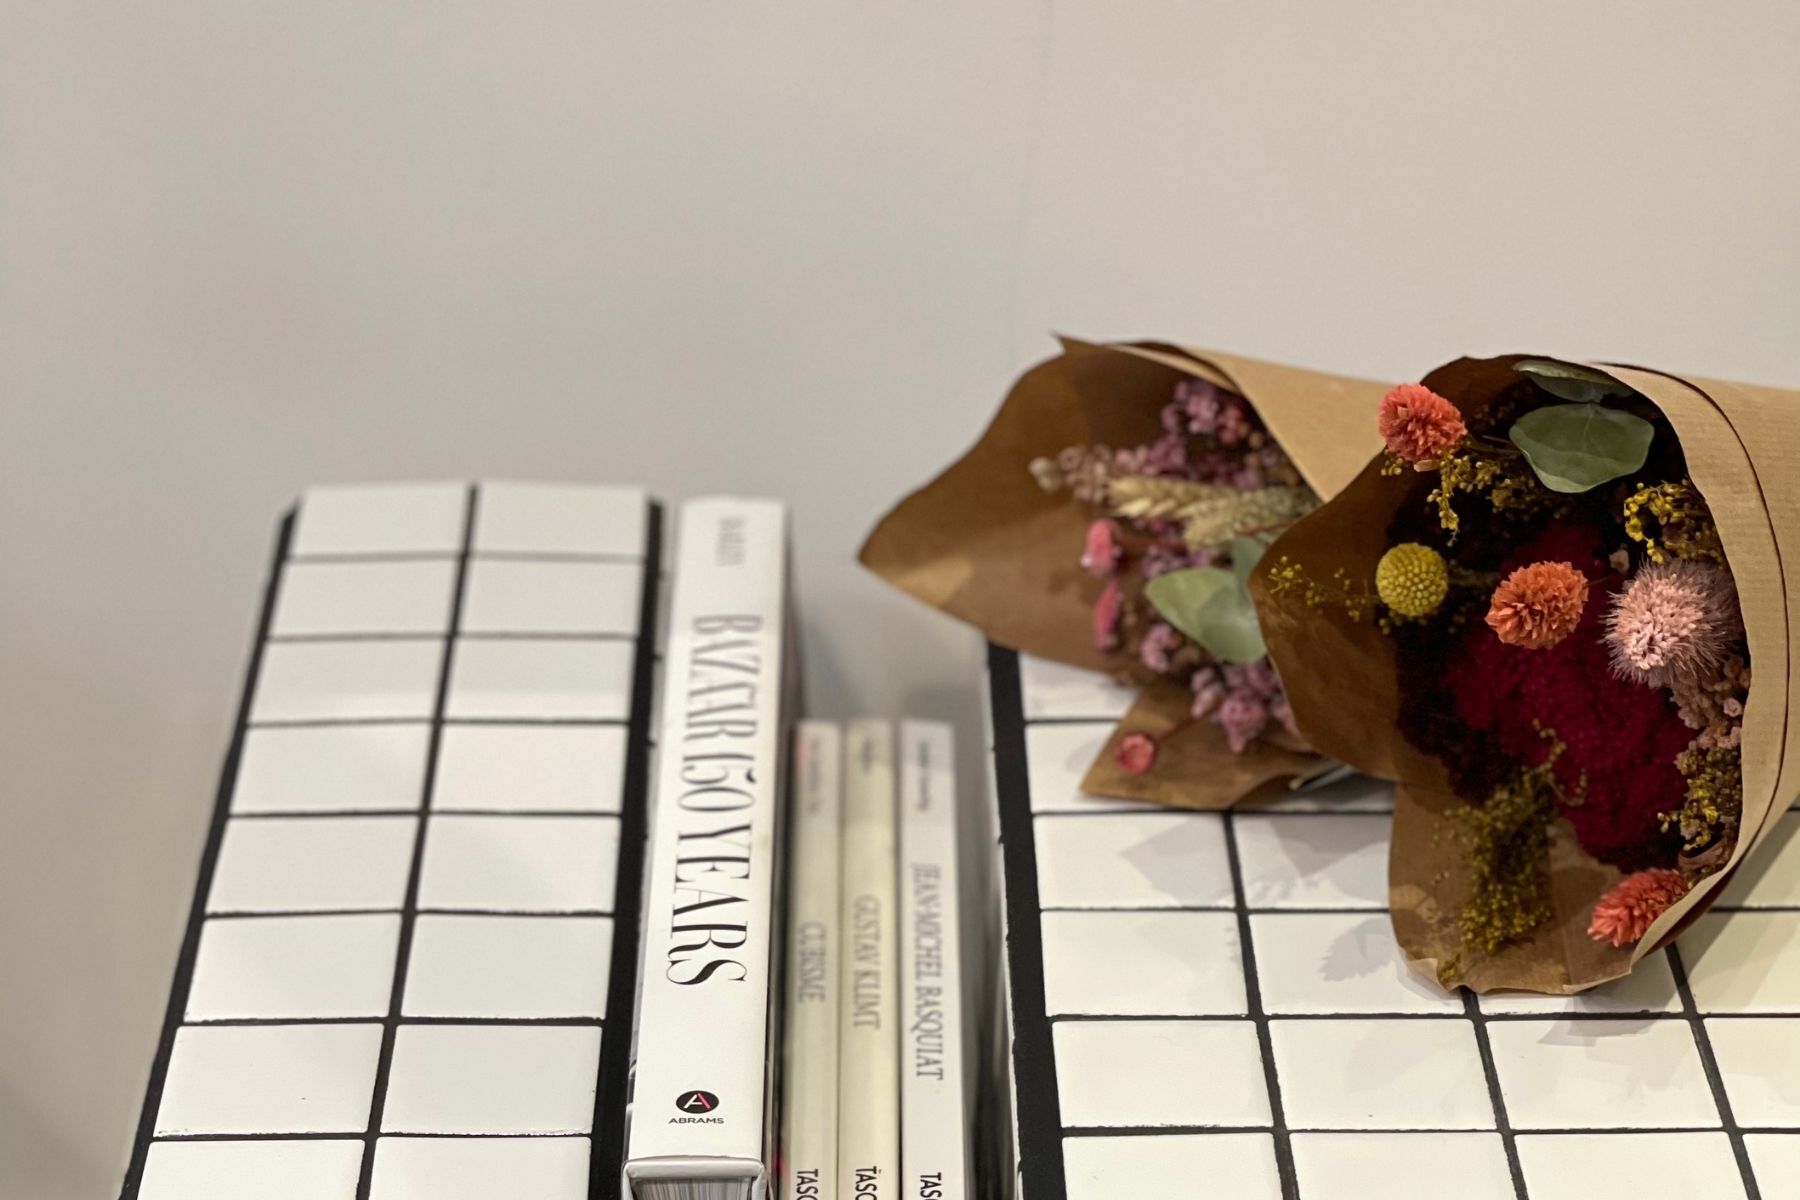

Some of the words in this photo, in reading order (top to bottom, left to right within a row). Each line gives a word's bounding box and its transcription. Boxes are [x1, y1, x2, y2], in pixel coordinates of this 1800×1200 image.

[666, 823, 752, 986] YEARS
[853, 893, 881, 966] GUSTAV
[852, 969, 882, 1029] KLIMT
[911, 984, 944, 1081] BASQUIAT
[668, 1117, 725, 1125] ABRAMS
